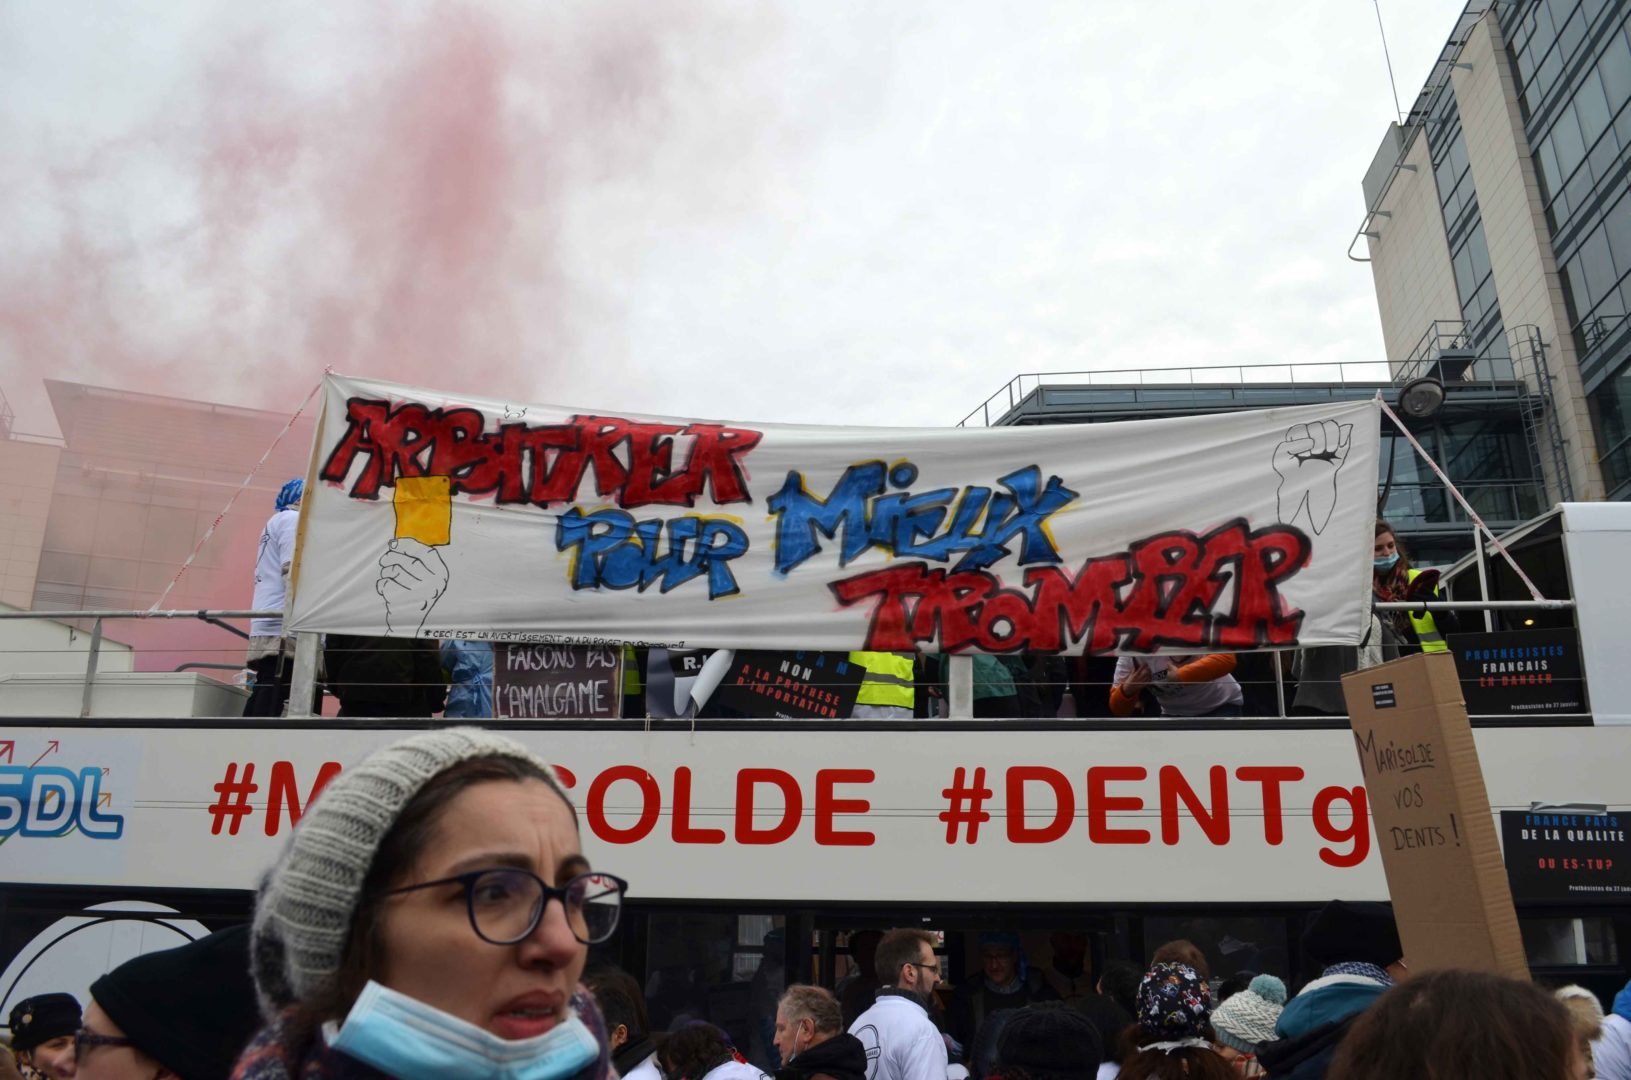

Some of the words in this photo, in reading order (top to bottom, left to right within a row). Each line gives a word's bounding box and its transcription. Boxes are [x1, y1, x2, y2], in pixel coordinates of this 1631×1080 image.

[319, 397, 763, 507] ARBITRER
[556, 506, 750, 600] POUR
[829, 517, 1313, 651] TROMPER
[455, 631, 476, 639] EST
[1465, 646, 1564, 661] PROTHESISTES
[780, 660, 812, 681] NON
[1483, 660, 1548, 673] FRANCAIS
[742, 664, 750, 675] A
[755, 669, 770, 682] LA
[775, 675, 840, 706] PROTHESE
[1479, 676, 1495, 688] EN
[1502, 674, 1552, 686] DANGER
[496, 679, 609, 719] L'AMALGAME
[736, 676, 837, 718] D'IMPORTATION
[1394, 783, 1424, 809] VOS
[1525, 815, 1578, 827] FRANCE
[1584, 816, 1618, 827] PAYS
[1521, 829, 1537, 840] DE
[1545, 829, 1560, 840] LA
[1567, 830, 1625, 842] QUALITE
[1538, 858, 1556, 869] OU
